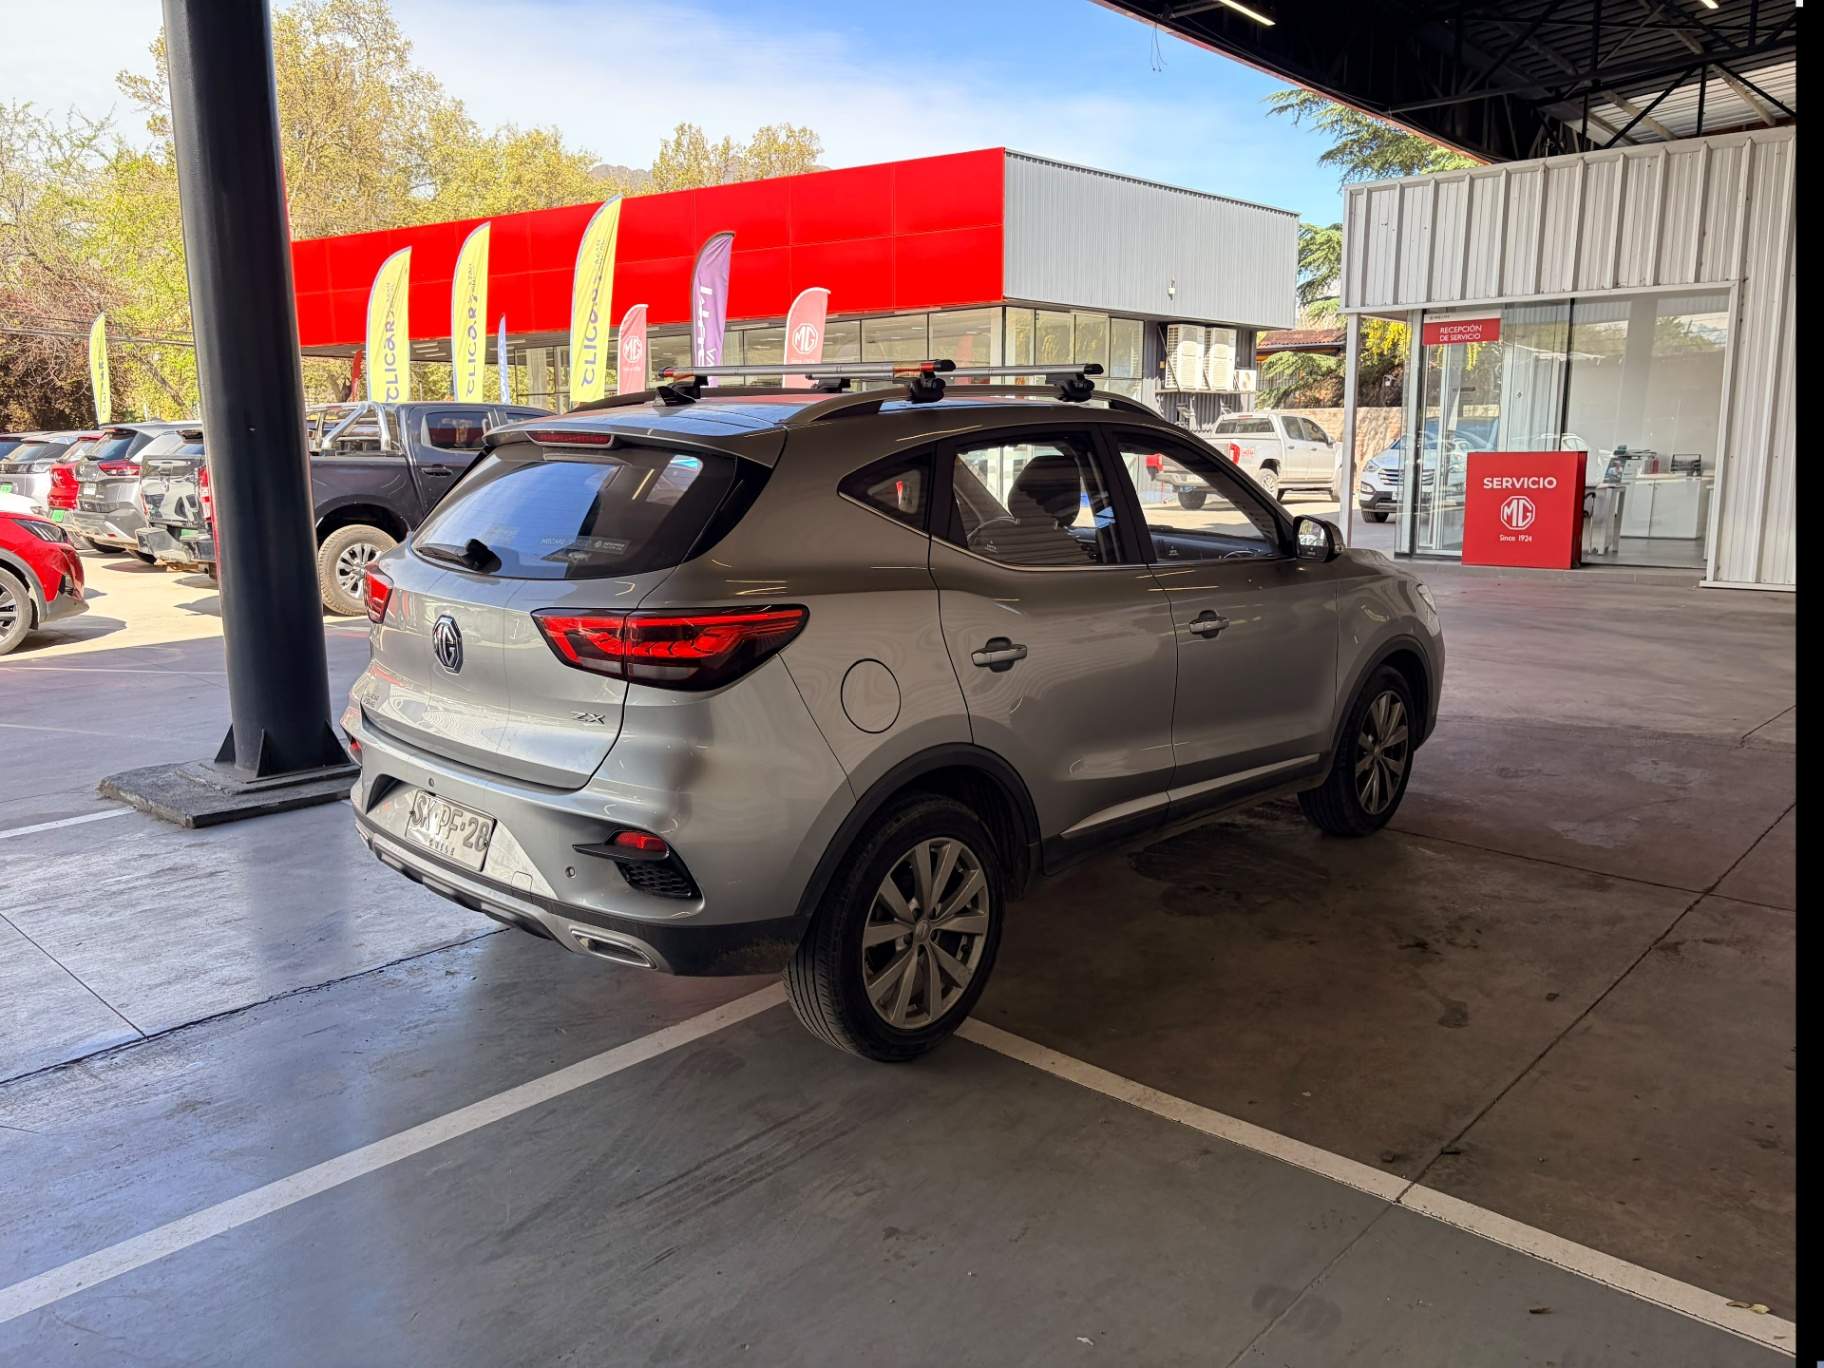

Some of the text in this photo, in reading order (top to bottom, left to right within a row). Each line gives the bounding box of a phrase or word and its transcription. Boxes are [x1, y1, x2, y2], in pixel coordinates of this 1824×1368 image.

[1440, 324, 1482, 334] RECEPCIÓN
[794, 325, 817, 353] MG
[1440, 332, 1481, 342] DE SERVICIO
[1483, 477, 1557, 489] SERVICIO
[1503, 498, 1532, 528] MG
[1499, 534, 1532, 543] Since 1924
[435, 619, 460, 670] MG
